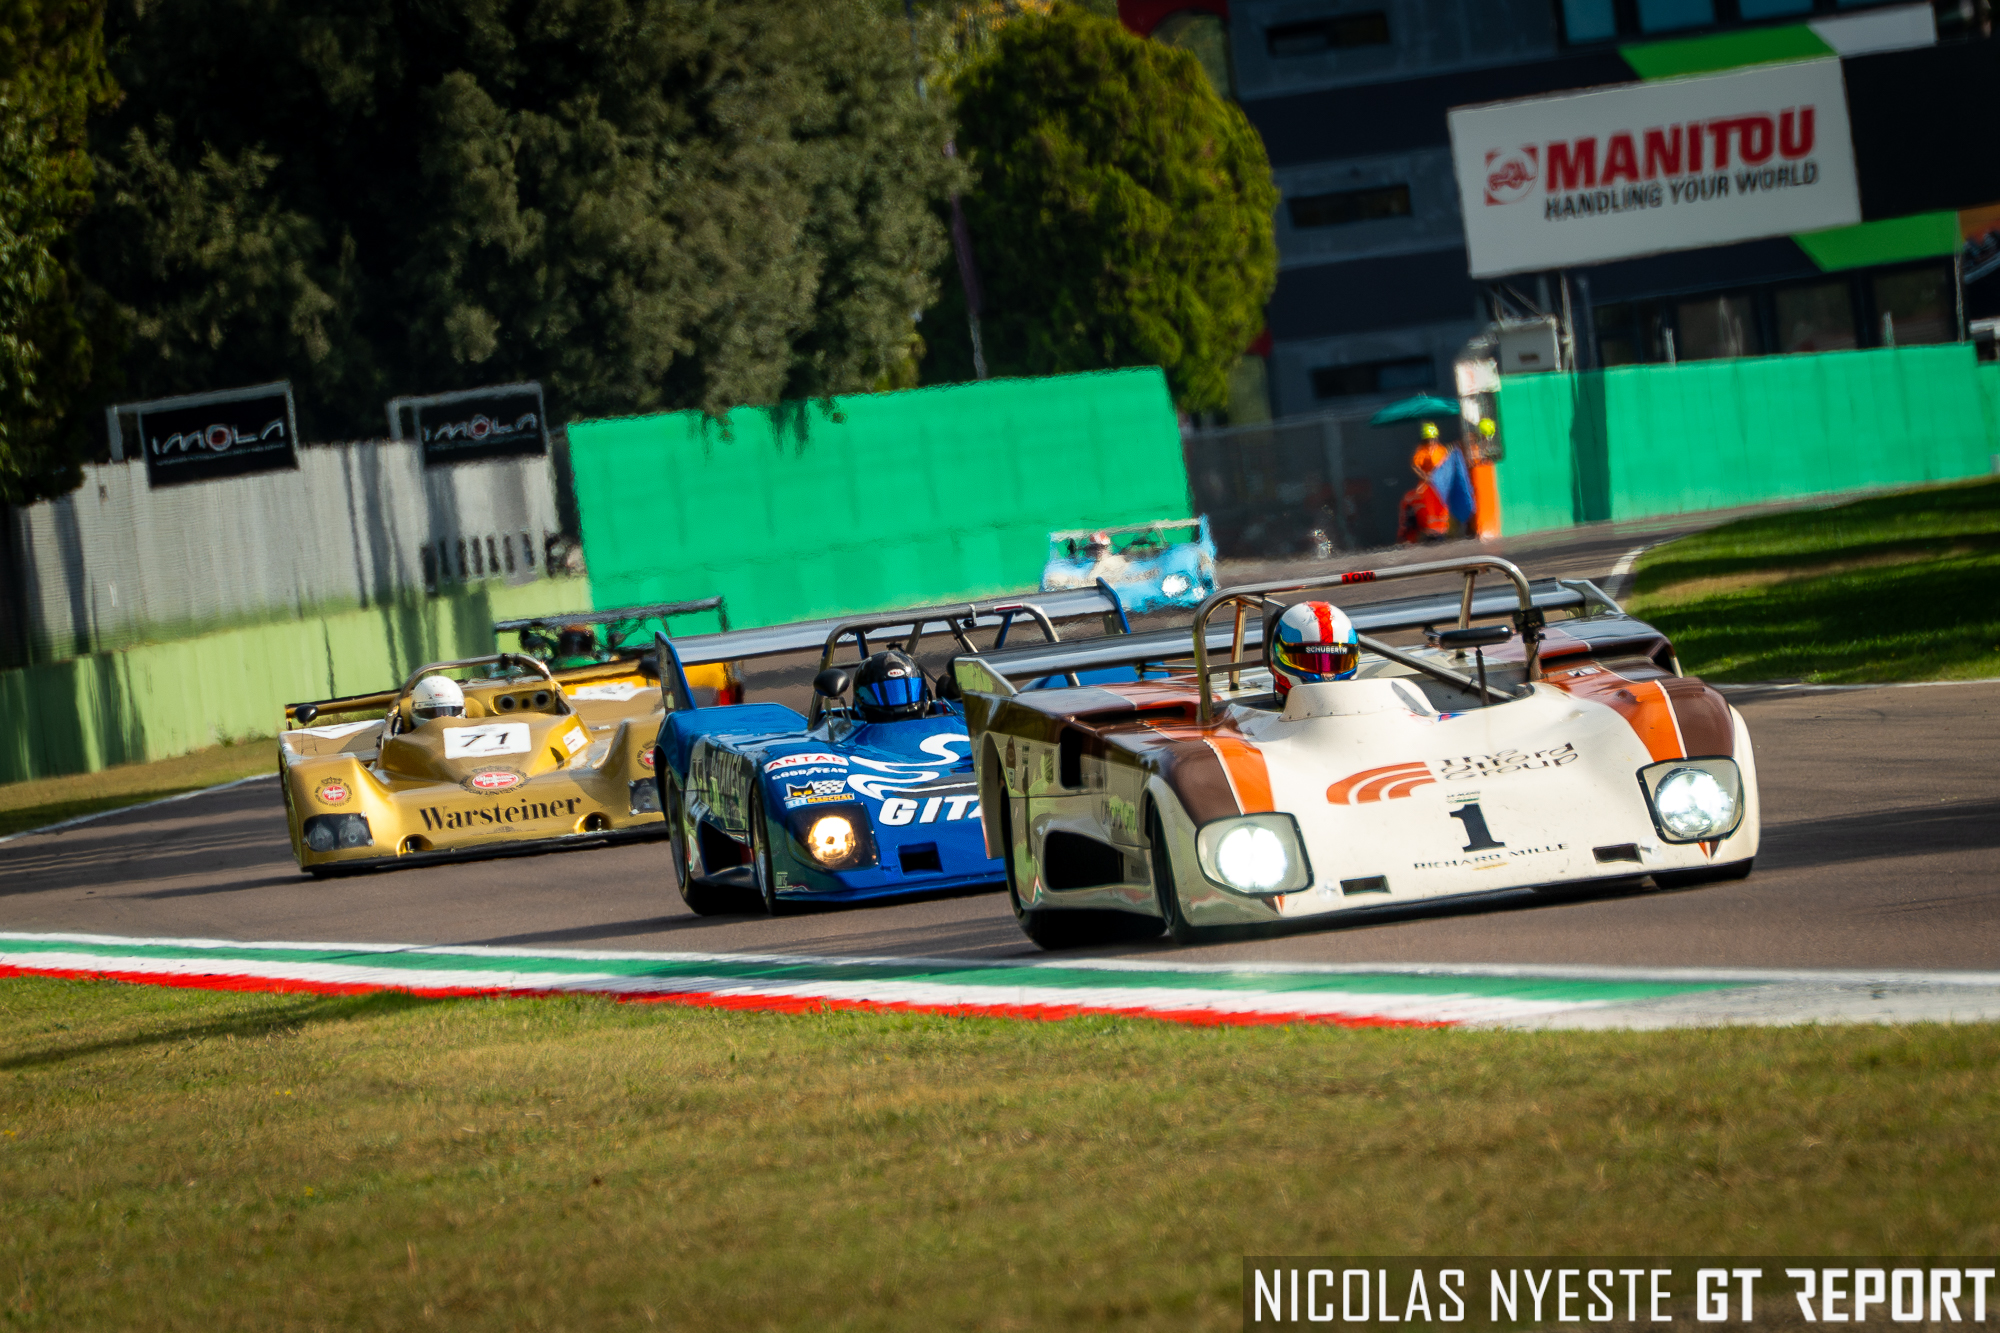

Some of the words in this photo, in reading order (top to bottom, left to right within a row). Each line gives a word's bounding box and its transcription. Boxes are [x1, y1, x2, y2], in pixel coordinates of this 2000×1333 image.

[1546, 104, 1815, 193] MANITOU
[1544, 179, 1663, 222] HANDLING
[1668, 172, 1729, 206] YOUR
[1735, 160, 1819, 195] WORLD
[1305, 645, 1349, 654] SCHUBERTH
[460, 731, 510, 748] 71
[768, 755, 843, 770] ANTAR
[807, 794, 853, 804] MARCHAL
[419, 797, 582, 831] Warsteiner
[1449, 803, 1507, 853] 1
[1413, 853, 1501, 870] RICHARD
[1509, 843, 1570, 857] MILLE
